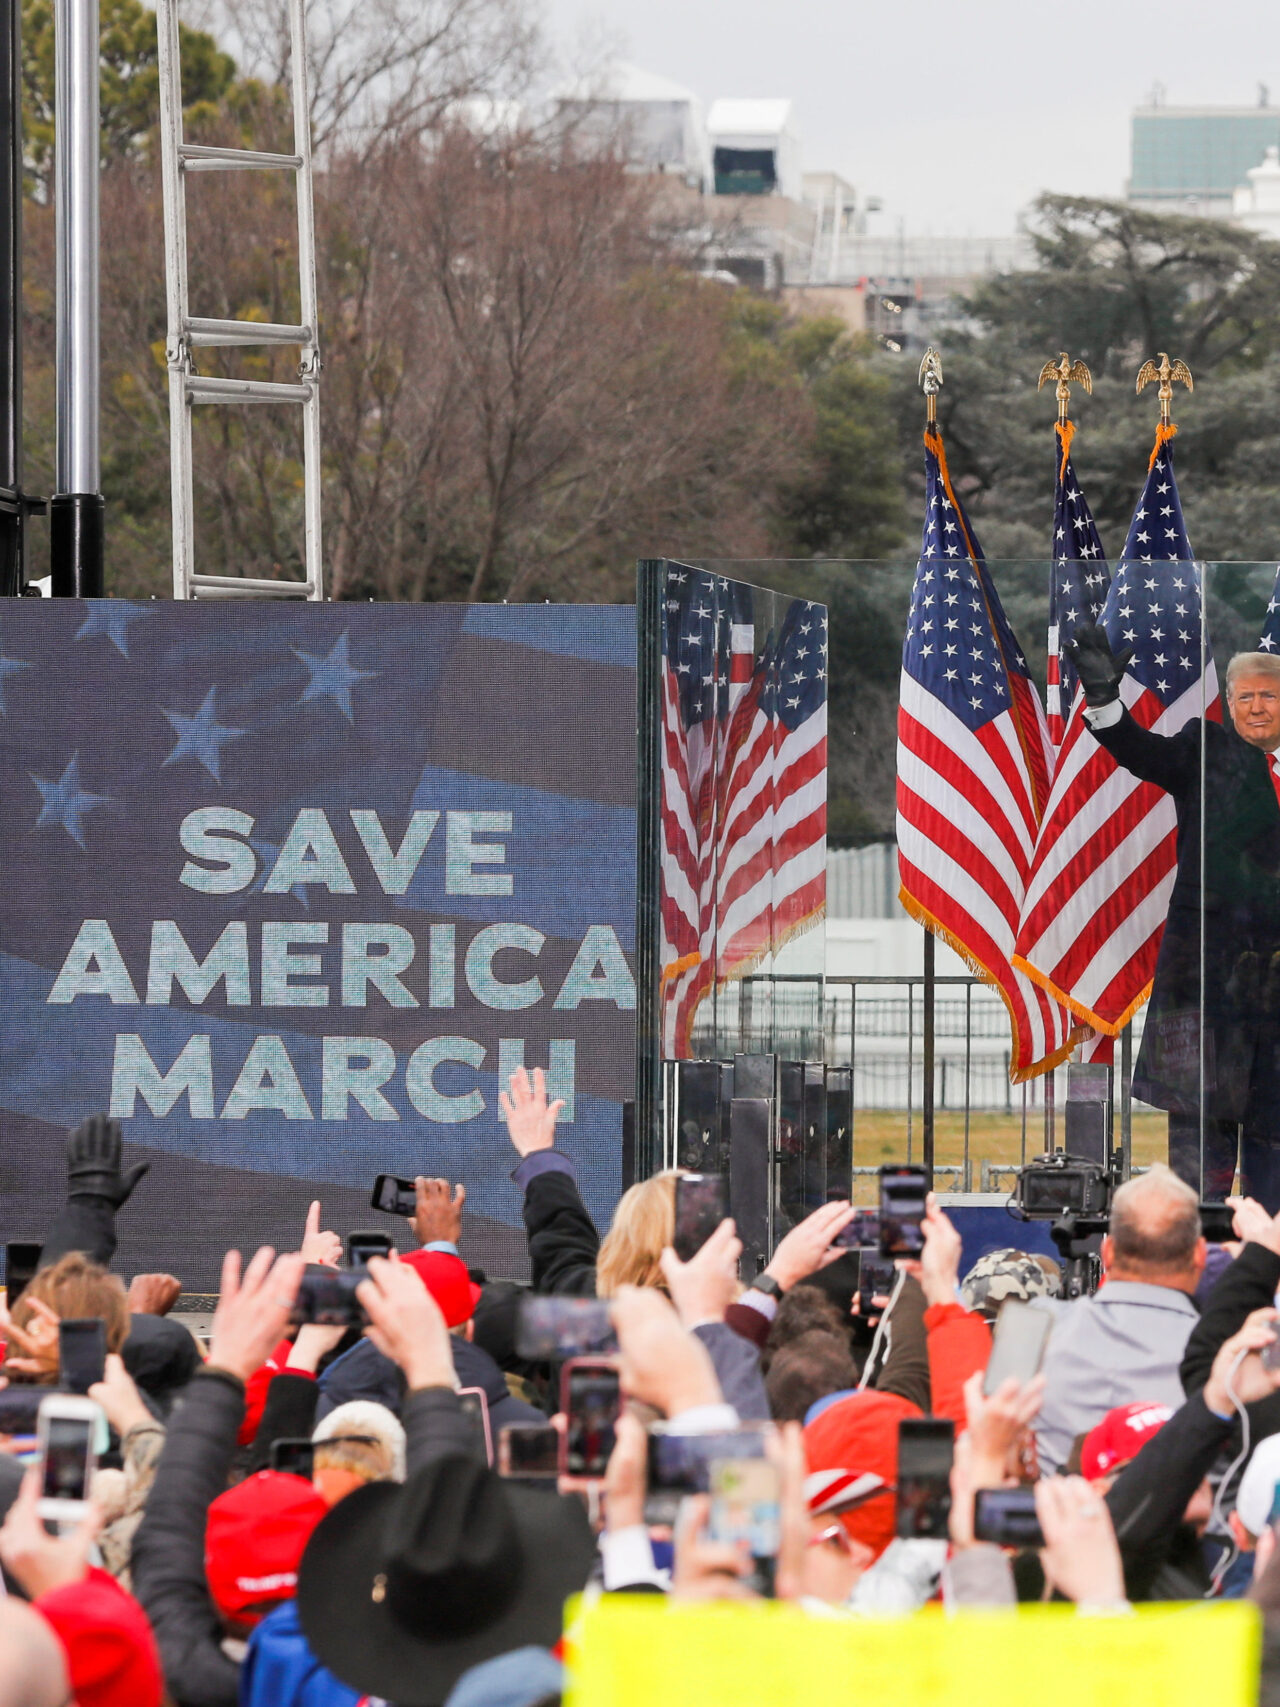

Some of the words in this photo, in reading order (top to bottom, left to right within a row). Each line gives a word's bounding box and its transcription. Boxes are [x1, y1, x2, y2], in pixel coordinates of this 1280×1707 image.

[178, 806, 515, 896] SAVE
[46, 919, 638, 1011] AMERICA
[109, 1033, 576, 1123] MARCH
